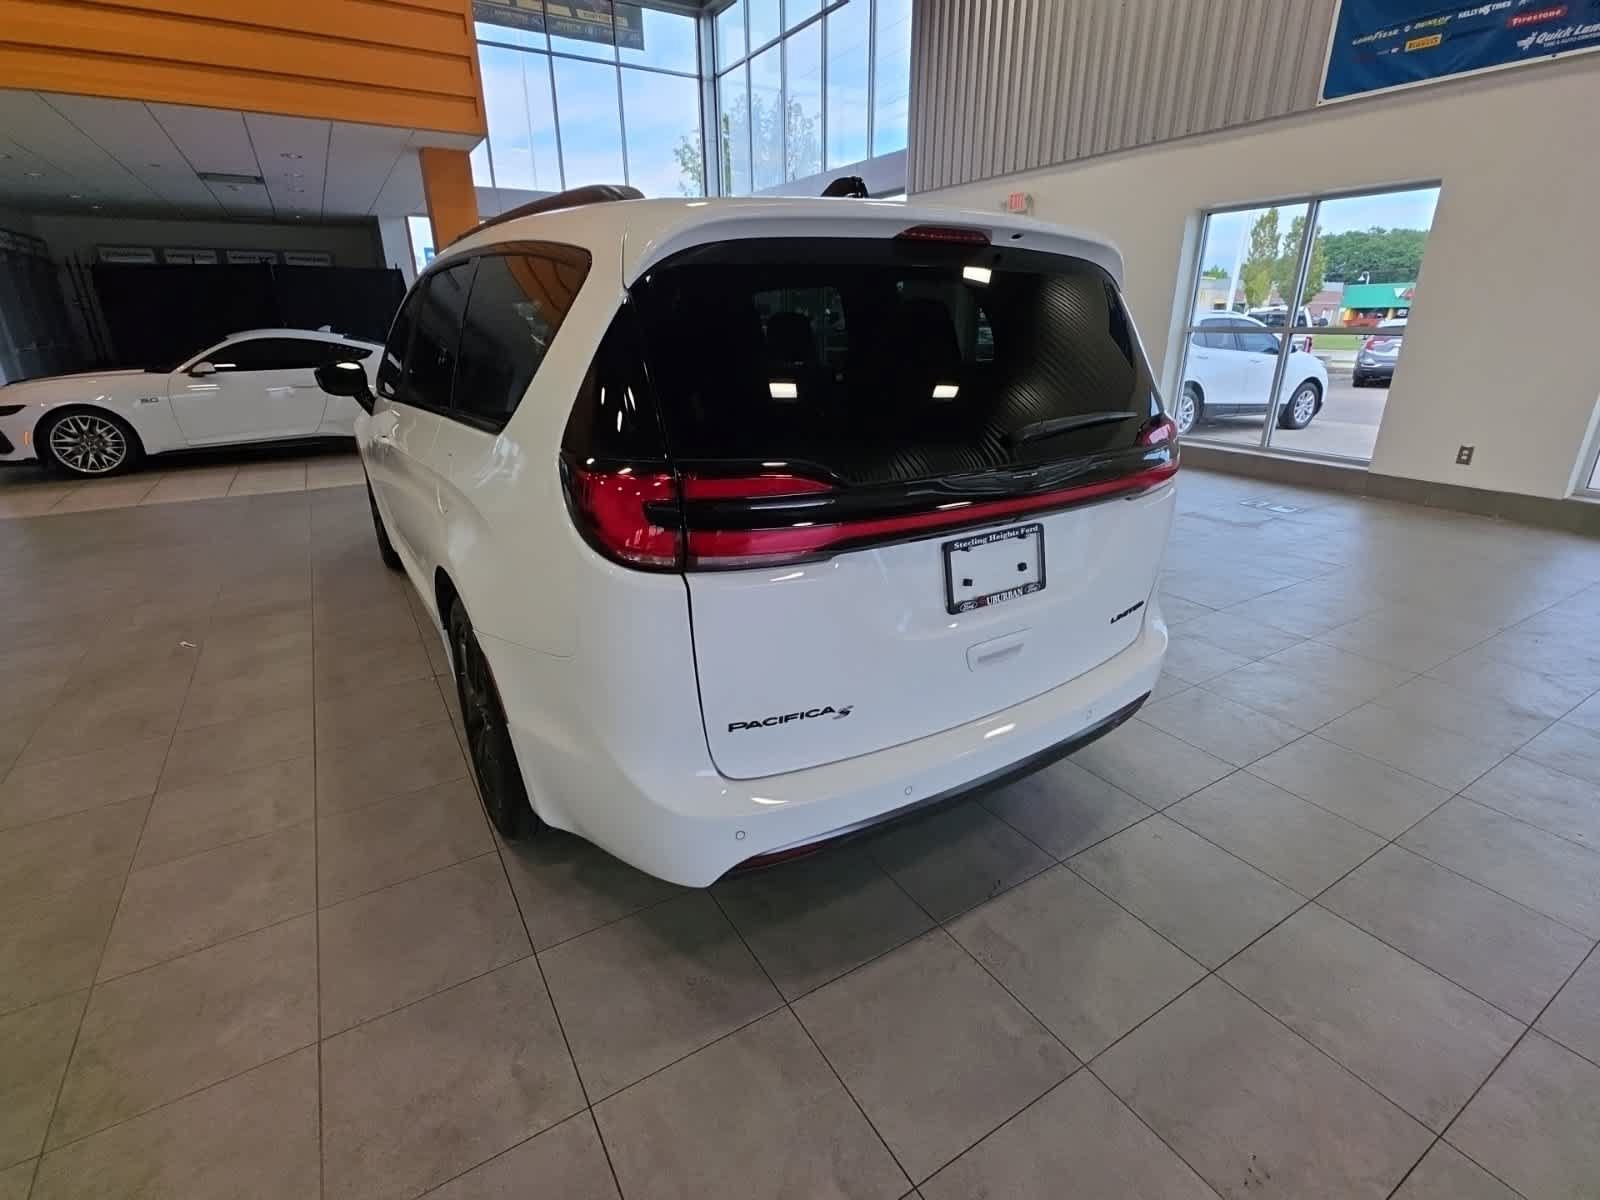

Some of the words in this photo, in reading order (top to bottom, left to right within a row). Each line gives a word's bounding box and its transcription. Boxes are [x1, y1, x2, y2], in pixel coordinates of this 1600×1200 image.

[1536, 26, 1575, 44] Quick
[1573, 23, 1600, 36] Lan
[953, 537, 988, 550] Sterling
[989, 529, 1019, 542] Heights
[1020, 525, 1039, 536] Ford
[728, 706, 836, 733] PACIFICA
